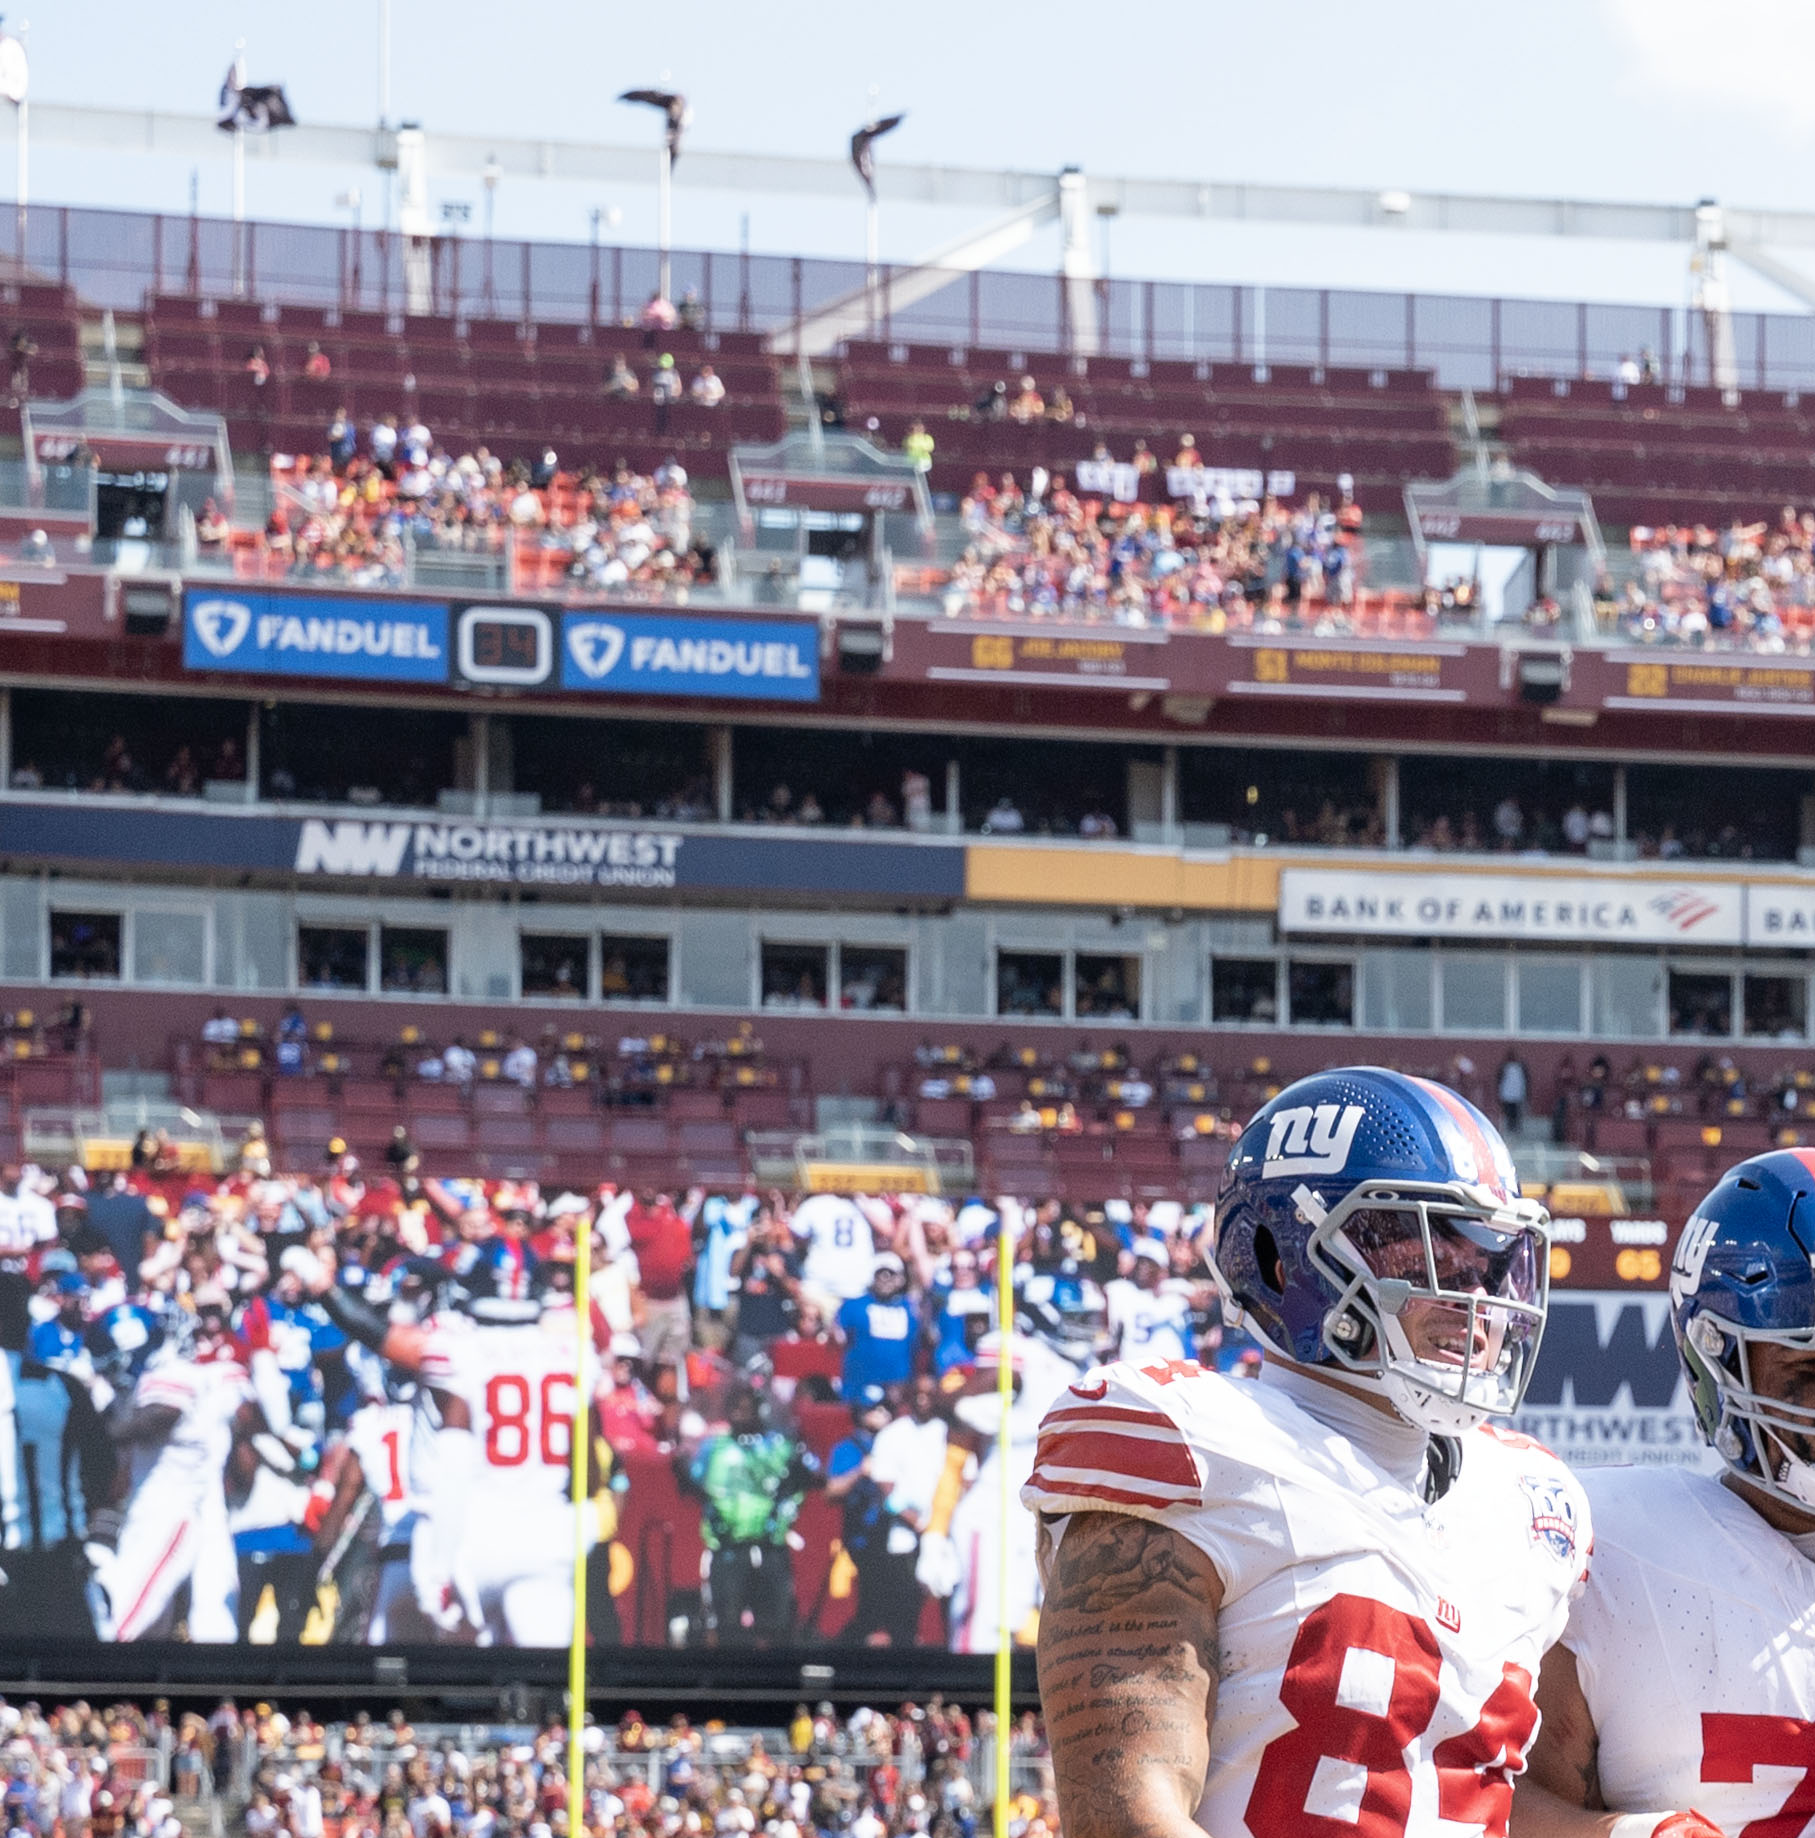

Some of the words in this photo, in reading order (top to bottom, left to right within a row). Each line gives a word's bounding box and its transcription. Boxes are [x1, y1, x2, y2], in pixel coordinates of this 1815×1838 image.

[257, 615, 441, 660] FANDUEL
[631, 636, 811, 679] FANDUEL
[296, 819, 411, 877] NW
[414, 825, 684, 868] NORTHWEST
[1306, 892, 1404, 923] BANK
[1415, 895, 1468, 926] OF
[1480, 898, 1637, 931] AMERICA
[486, 1374, 575, 1466] 86
